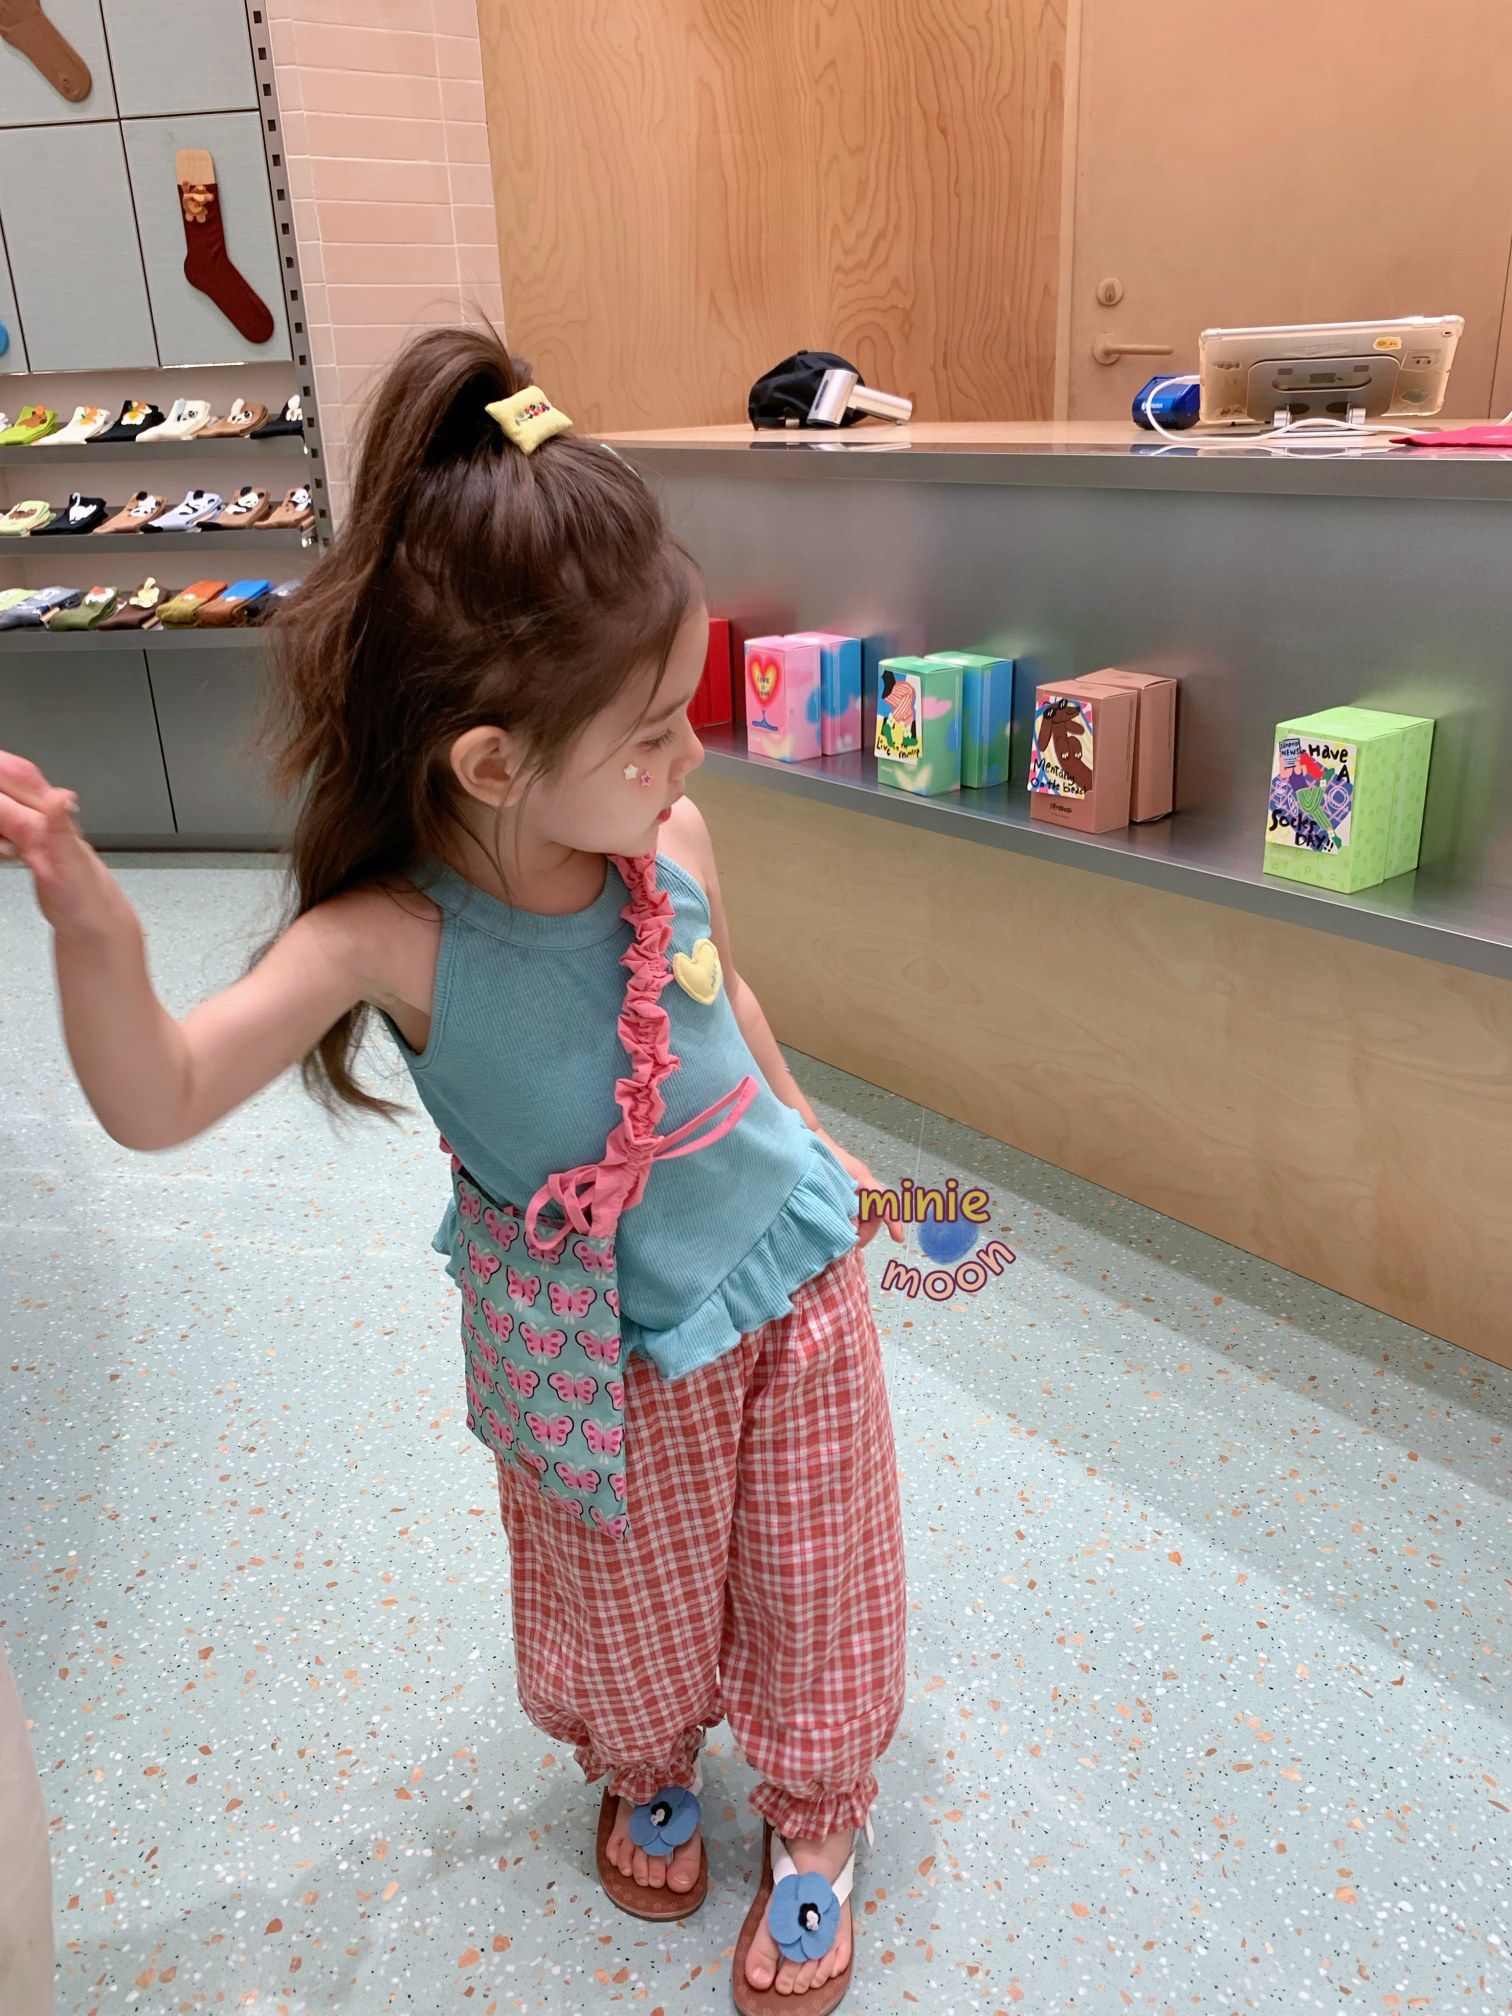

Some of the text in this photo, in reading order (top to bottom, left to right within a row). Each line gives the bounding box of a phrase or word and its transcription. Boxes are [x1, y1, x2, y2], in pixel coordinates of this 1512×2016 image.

[1281, 748, 1300, 756] NEWS
[1308, 743, 1349, 763] Have
[1336, 764, 1350, 784] A
[1269, 809, 1318, 834] Socks
